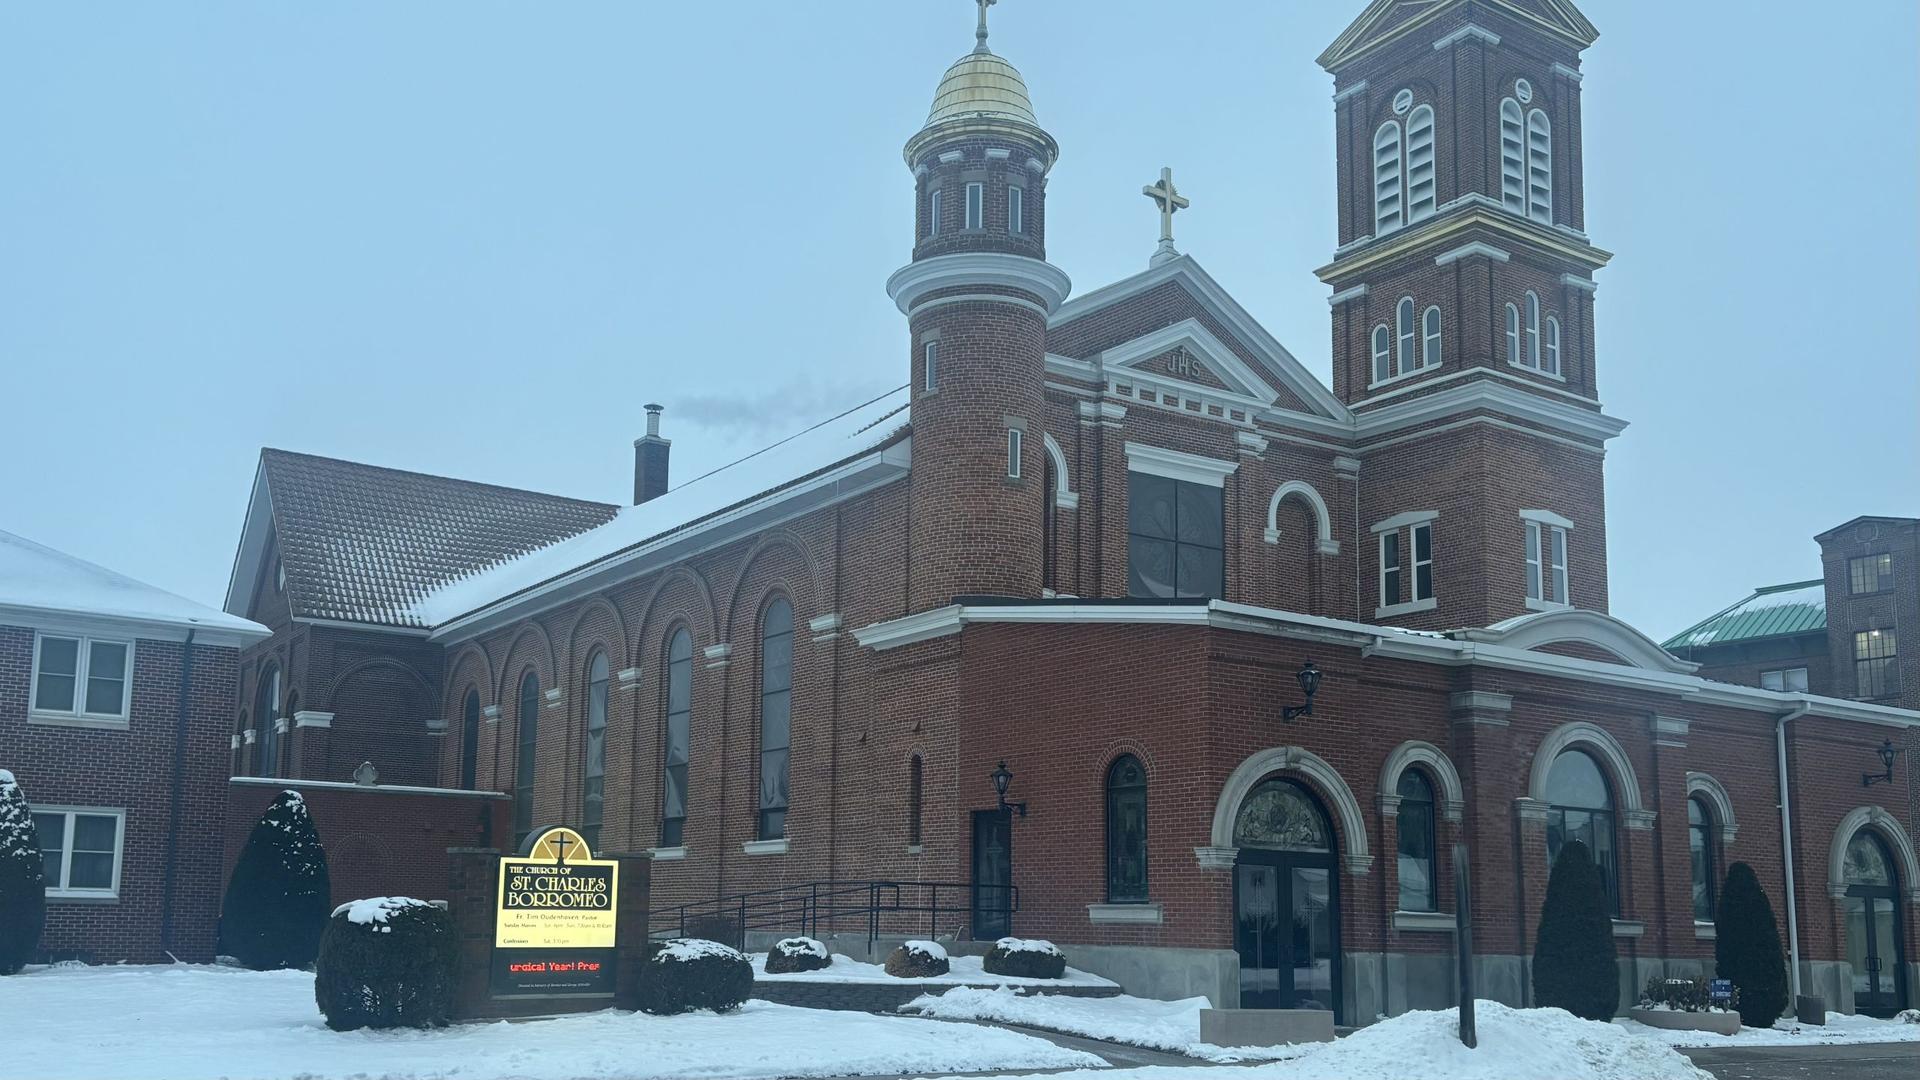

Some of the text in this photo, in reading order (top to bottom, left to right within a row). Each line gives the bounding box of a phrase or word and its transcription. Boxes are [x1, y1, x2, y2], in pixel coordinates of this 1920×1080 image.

[509, 866, 572, 875] THE CHURCH OF
[510, 876, 607, 891] ST. CHARLES
[507, 892, 608, 907] BORROMEO
[549, 962, 575, 971] Year!
